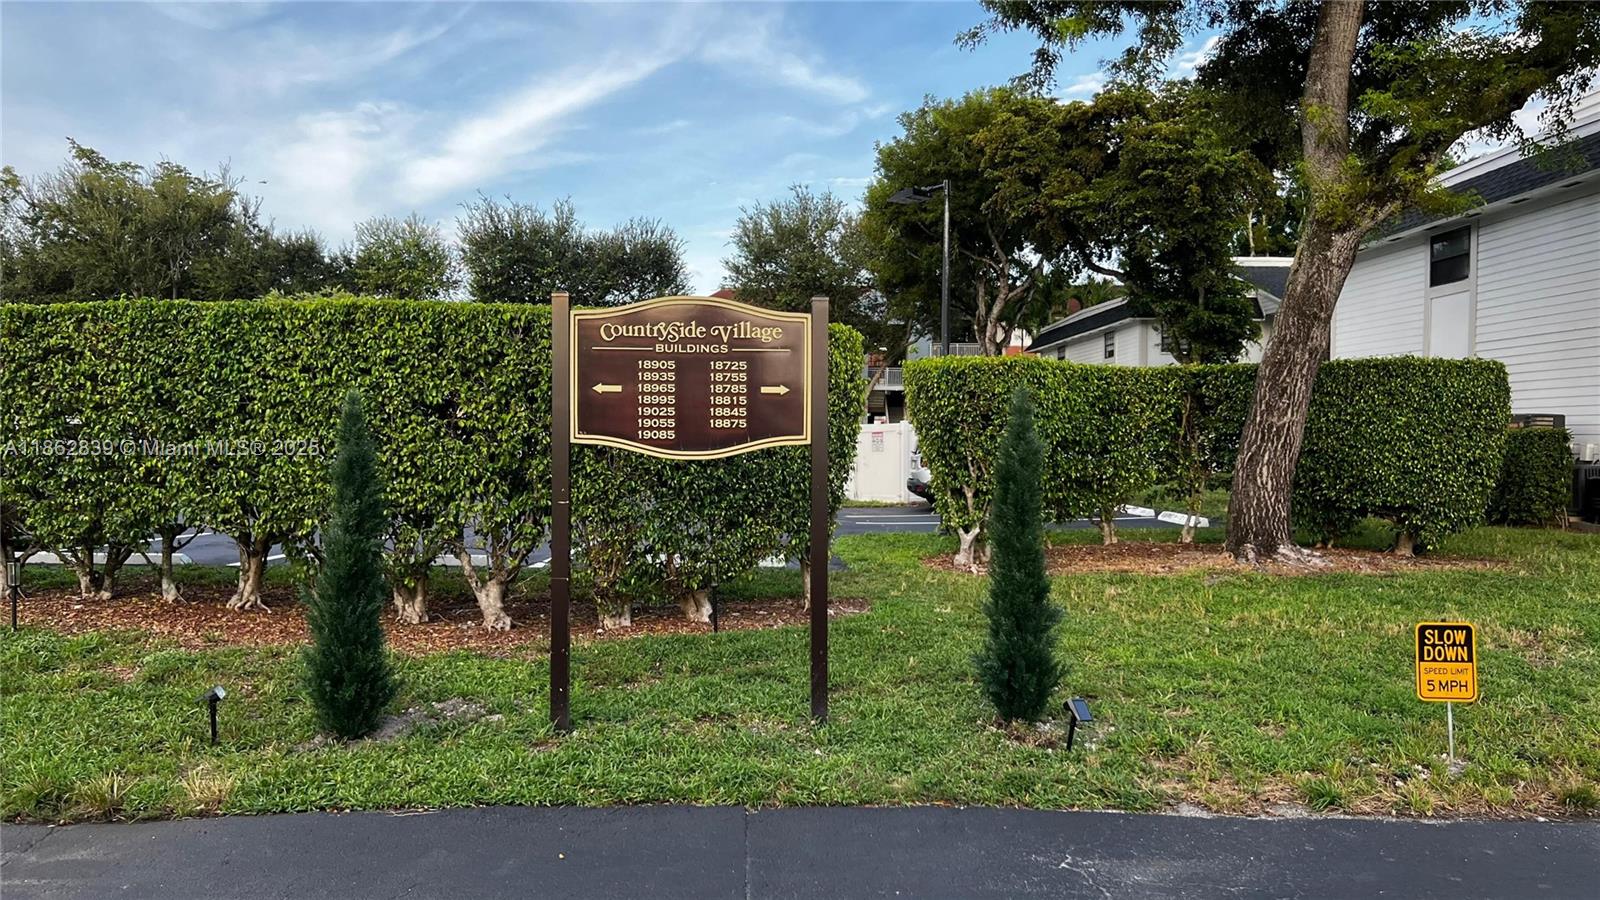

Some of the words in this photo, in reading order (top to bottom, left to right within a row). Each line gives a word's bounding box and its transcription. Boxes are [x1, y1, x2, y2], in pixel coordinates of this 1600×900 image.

[710, 321, 783, 343] Village
[655, 344, 729, 354] BUILDINGS
[638, 360, 675, 369] 18905
[710, 361, 747, 370] 18725
[638, 372, 675, 381] 18935
[710, 373, 747, 382] 18755
[638, 384, 675, 392] 18965
[710, 385, 747, 393] 18785
[638, 395, 675, 404] 18995
[710, 396, 747, 405] 18815
[638, 407, 675, 416] 19025
[710, 408, 747, 416] 18845
[638, 419, 675, 427] 19055
[710, 419, 747, 428] 18875
[638, 430, 675, 439] 19085
[1424, 629, 1466, 645] SLOW
[1424, 646, 1468, 661] DOWN
[1424, 667, 1448, 675] SPEED
[1426, 680, 1435, 692] 5
[1439, 680, 1468, 692] MPH
